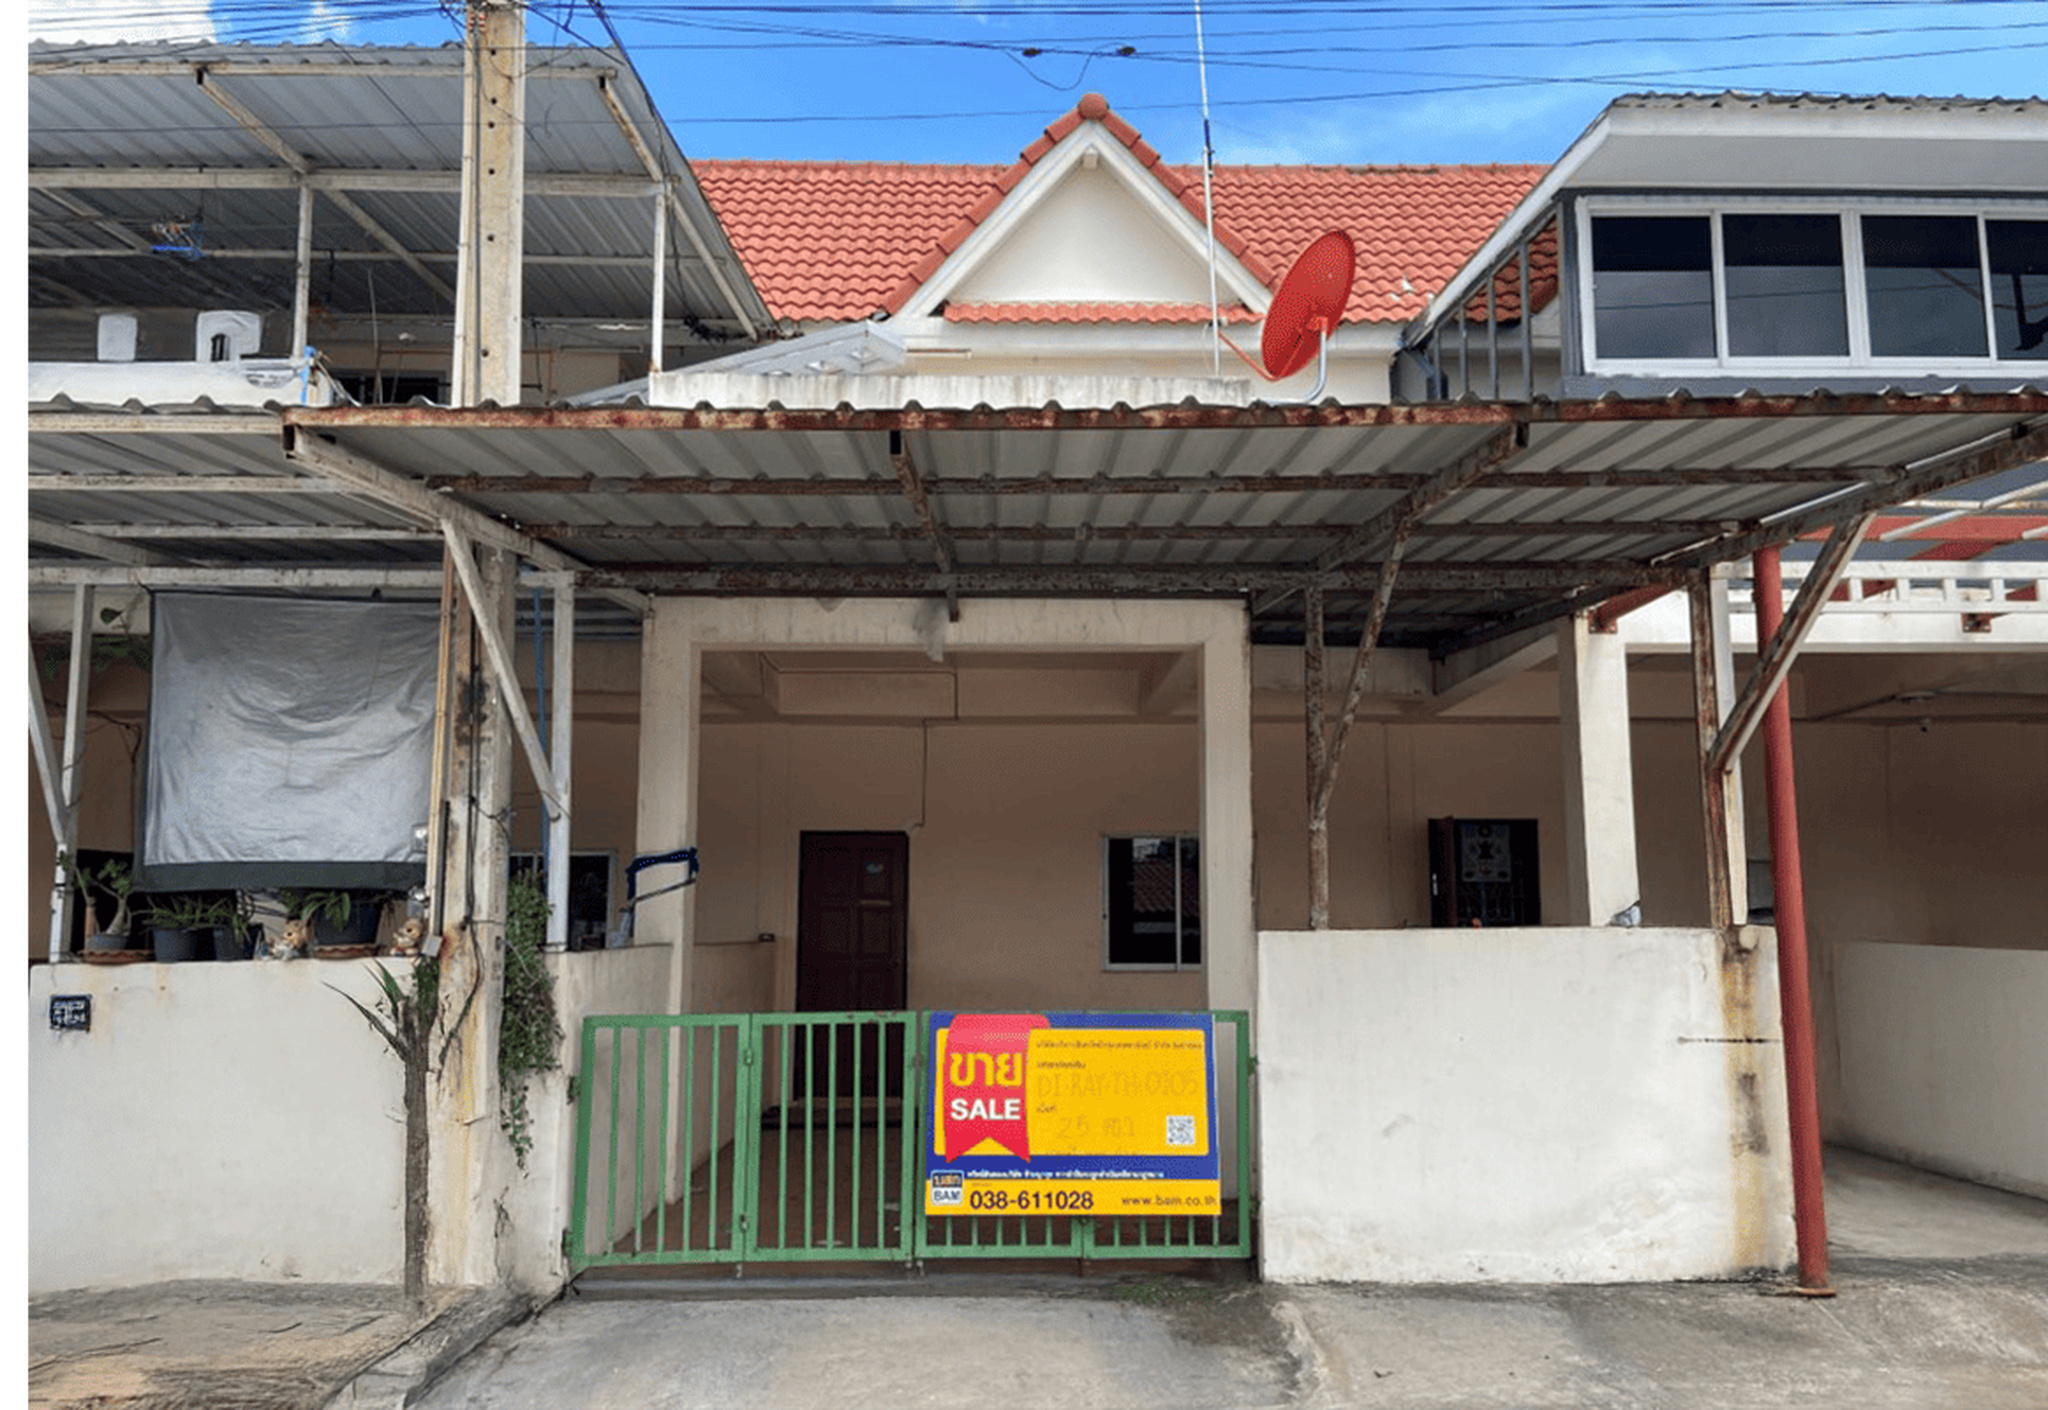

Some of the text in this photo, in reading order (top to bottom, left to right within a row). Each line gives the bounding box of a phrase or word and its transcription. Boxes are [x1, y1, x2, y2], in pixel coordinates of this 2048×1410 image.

[950, 1052, 1023, 1088] ขาย
[950, 1098, 1021, 1120] SALE
[933, 1190, 961, 1201] BAM
[970, 1190, 1094, 1210] 038-611028
